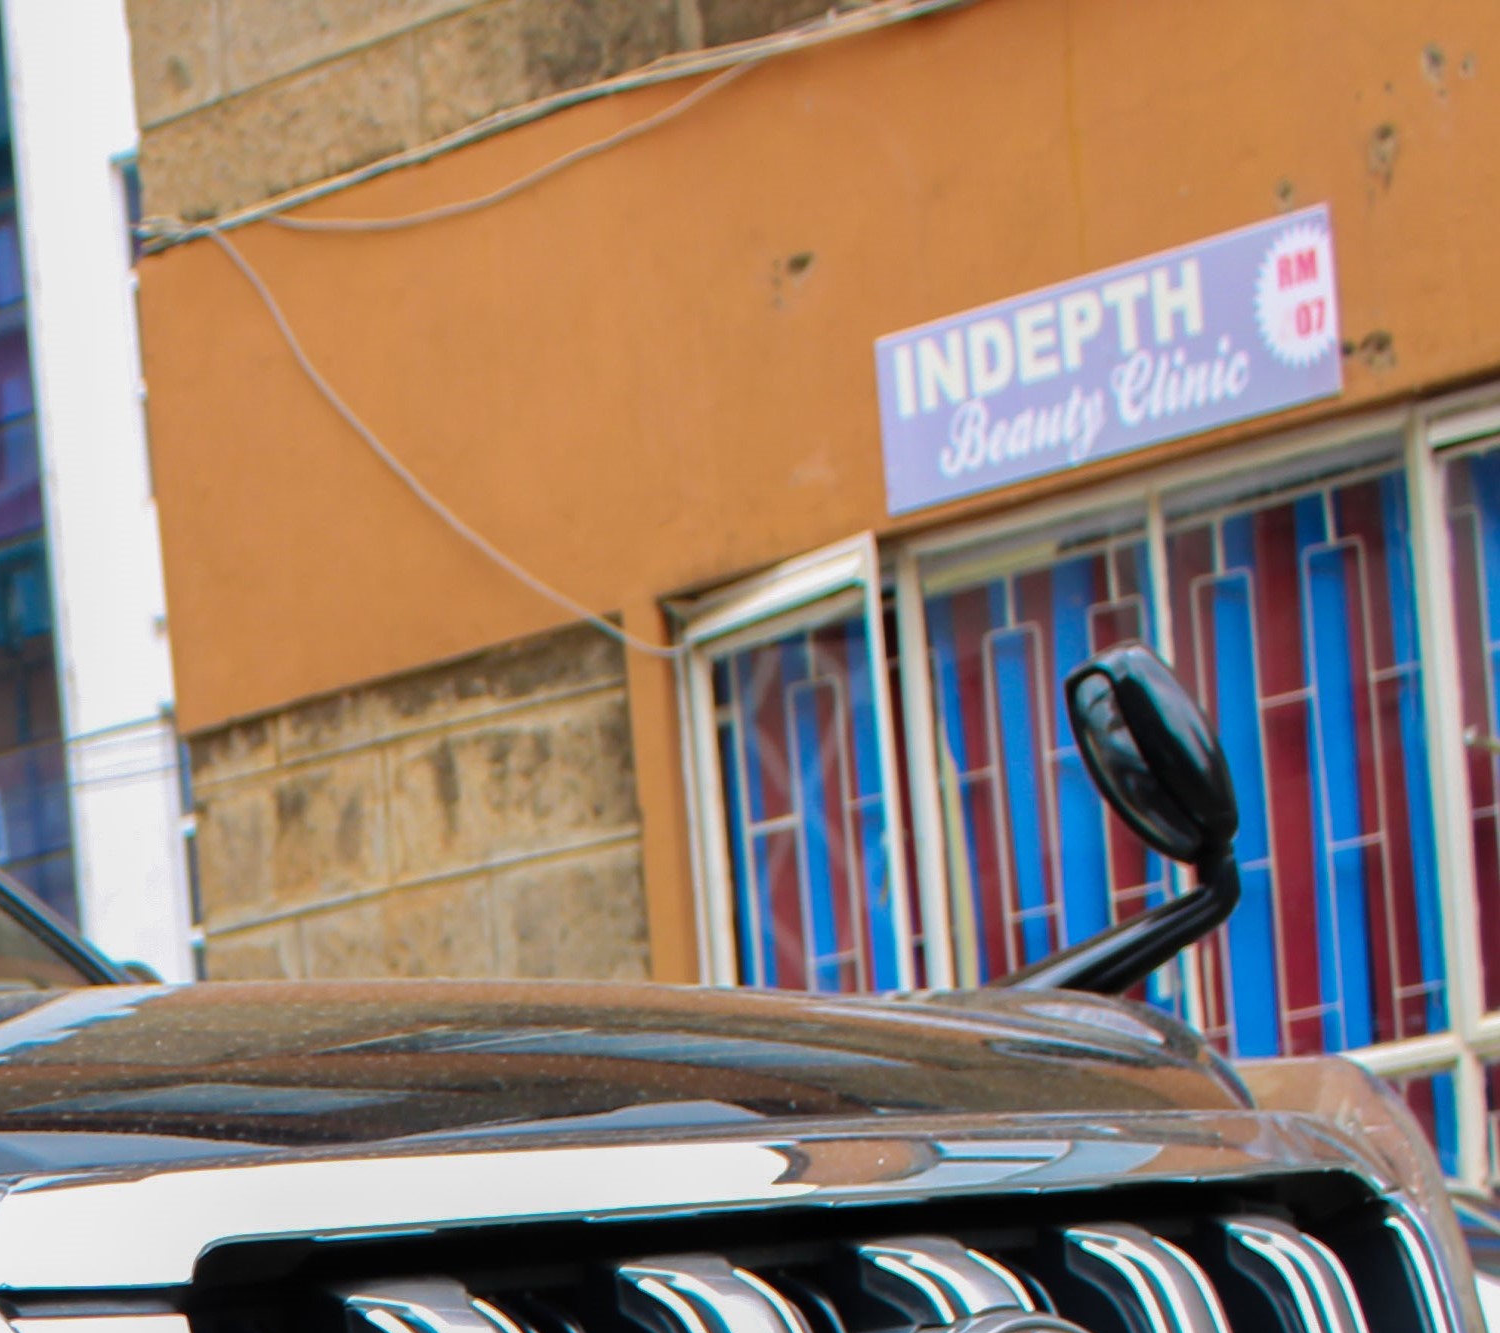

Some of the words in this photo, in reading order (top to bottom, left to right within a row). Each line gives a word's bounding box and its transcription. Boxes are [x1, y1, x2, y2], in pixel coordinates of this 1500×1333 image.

[894, 257, 1204, 418] INDEPTH
[939, 384, 1104, 478] Beauty
[1110, 334, 1250, 427] Clinic
